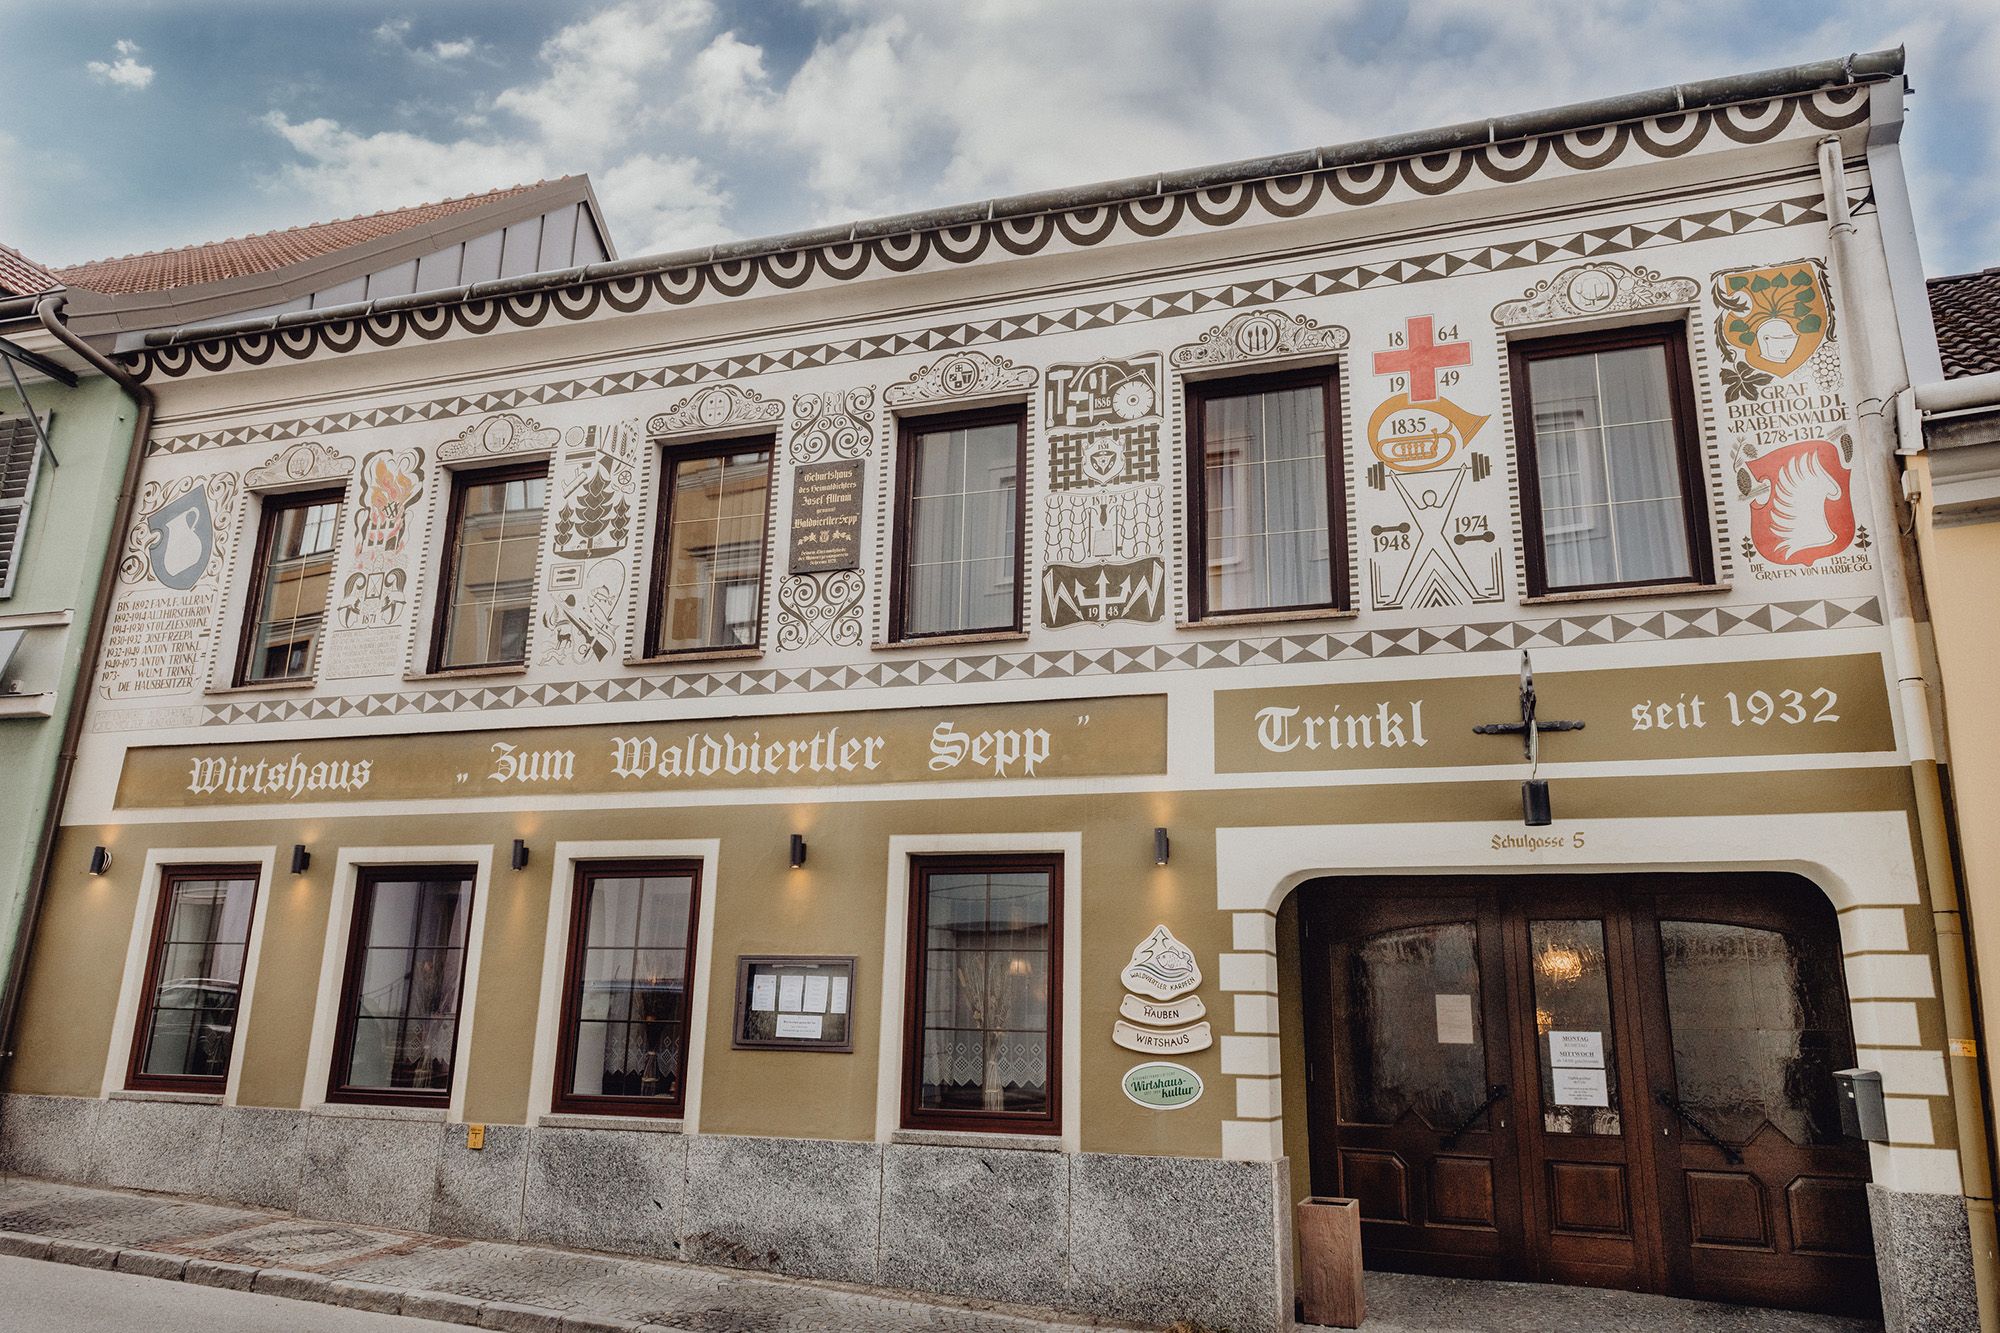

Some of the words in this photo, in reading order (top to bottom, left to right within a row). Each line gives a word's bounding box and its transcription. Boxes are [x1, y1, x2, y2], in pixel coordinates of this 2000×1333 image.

[1388, 331, 1404, 347] 18
[1438, 324, 1459, 341] 64
[1389, 376, 1405, 392] 19
[1440, 370, 1460, 386] 49
[1760, 381, 1809, 400] GRAF
[1094, 396, 1111, 409] 1886
[1728, 395, 1832, 419] BERCHTOLD
[1391, 417, 1426, 435] 1835
[1755, 425, 1825, 446] 1278-1312
[1455, 514, 1489, 533] 1974
[1372, 533, 1411, 553] 1948
[1749, 562, 1765, 574] DIE
[1755, 567, 1798, 581] GRAFEN
[1800, 566, 1819, 577] VON
[1820, 561, 1873, 576] HARDEGG
[361, 613, 377, 625] 1871
[1088, 607, 1099, 618] 19
[1107, 605, 1119, 617] 48
[117, 681, 132, 692] DIE
[1254, 697, 1429, 754] Trinkl
[1631, 692, 1707, 733] seit
[1723, 686, 1841, 727] 1932
[186, 752, 374, 799] Wirtshaus
[1491, 834, 1565, 852] Schulgasse
[1573, 831, 1585, 848] 5
[1129, 972, 1168, 991] WALDVIERTLER
[1170, 976, 1196, 991] KARPFEN
[1143, 1007, 1180, 1019] HAUBEN
[1136, 1033, 1190, 1048] WIRTSHAUS
[1161, 1086, 1194, 1098] kultur
